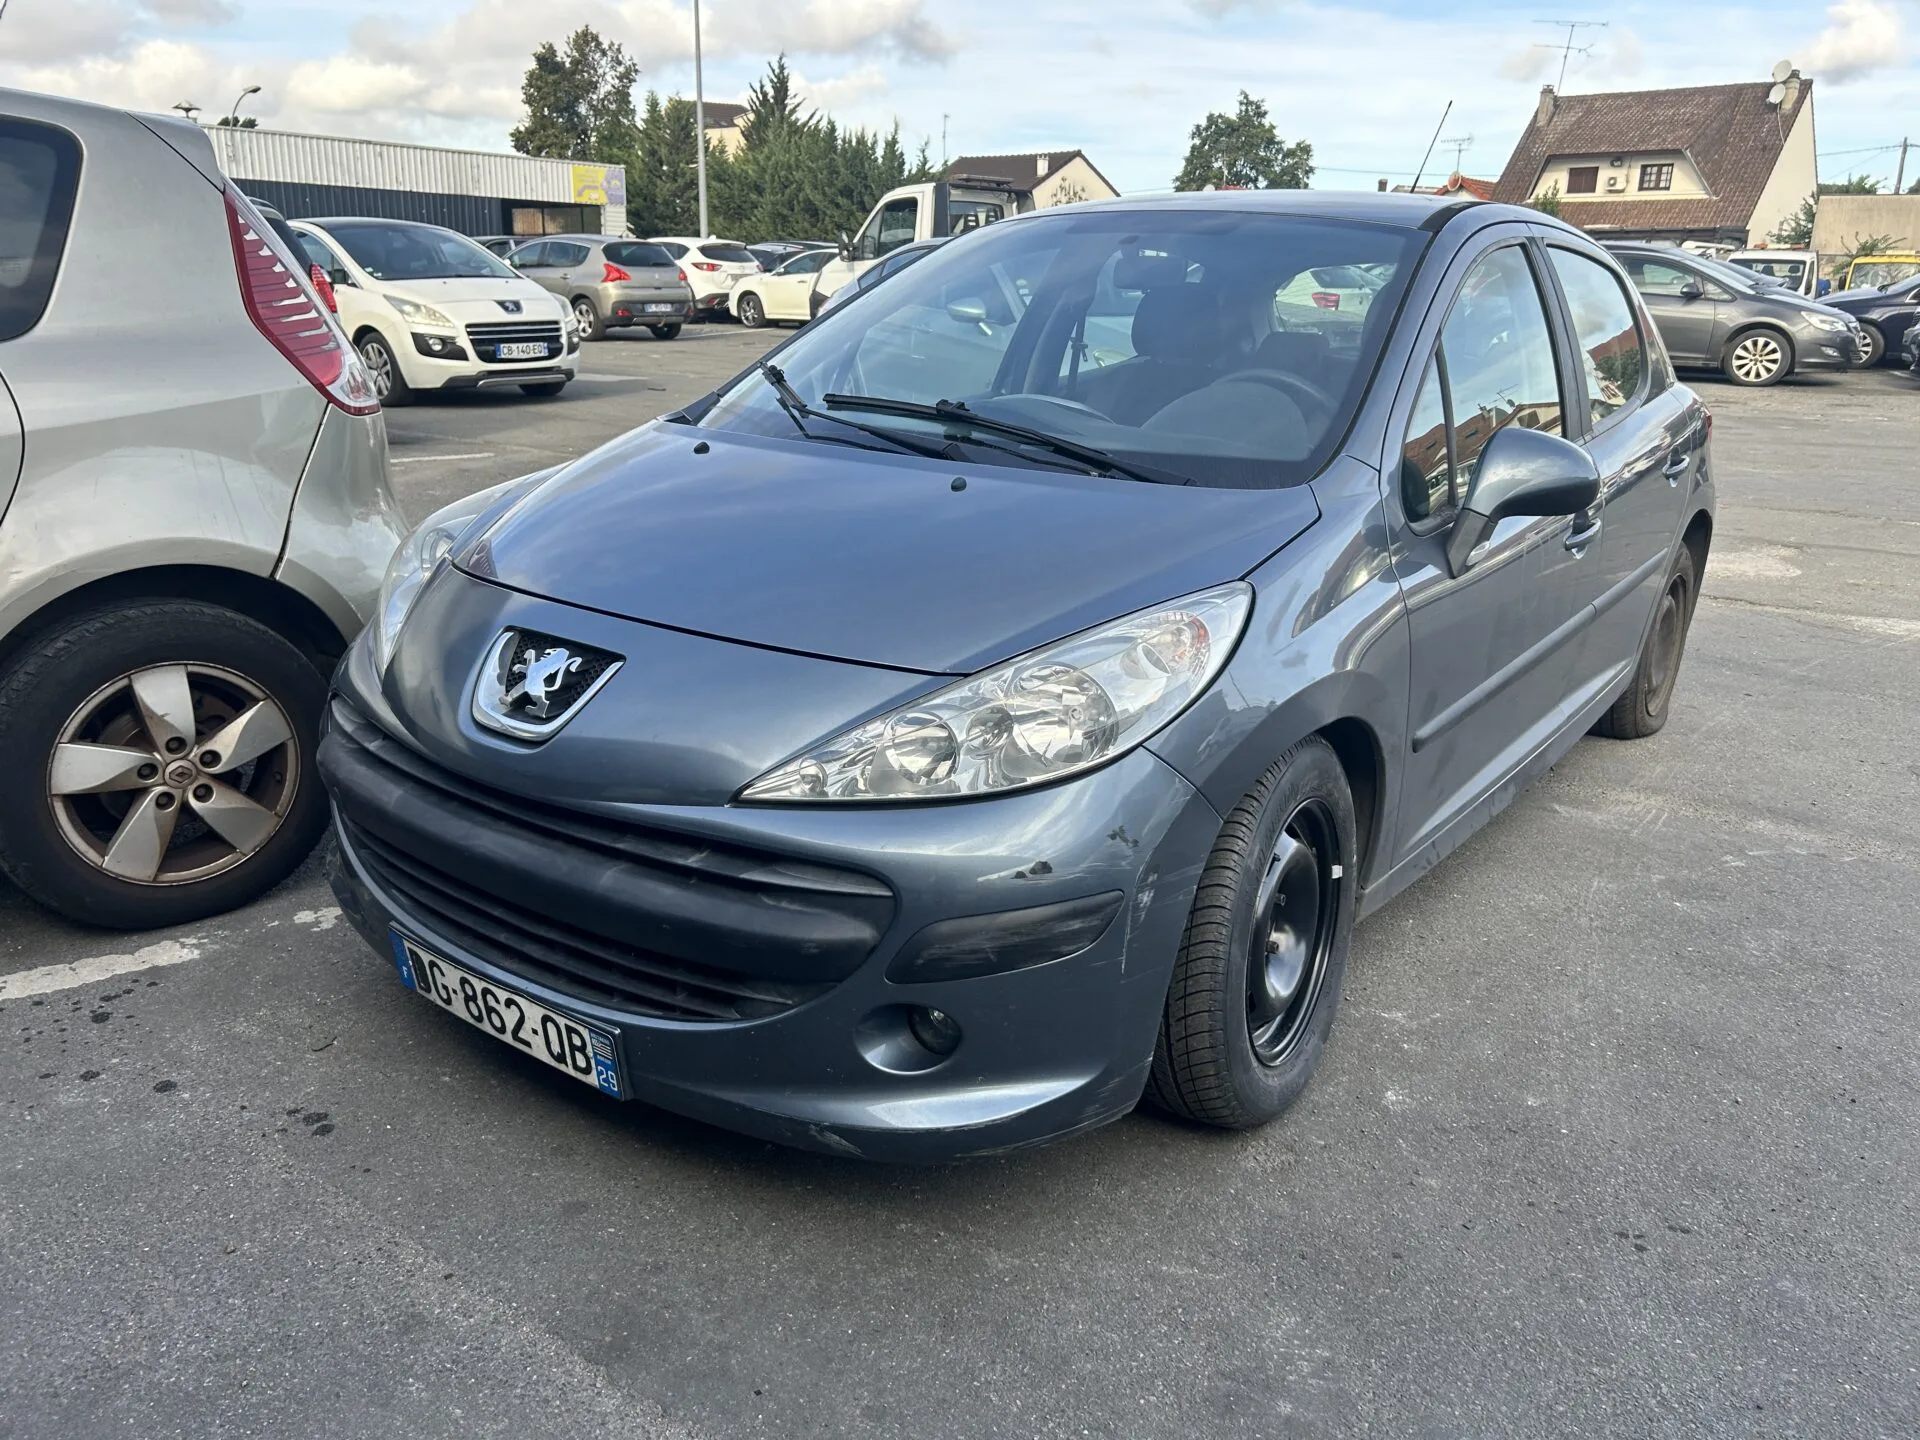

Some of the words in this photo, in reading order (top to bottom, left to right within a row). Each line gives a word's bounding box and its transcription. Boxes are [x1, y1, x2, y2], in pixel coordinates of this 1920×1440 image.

[402, 965, 408, 978] F
[407, 946, 593, 1076] DG-862-QB
[597, 1065, 618, 1091] 29
